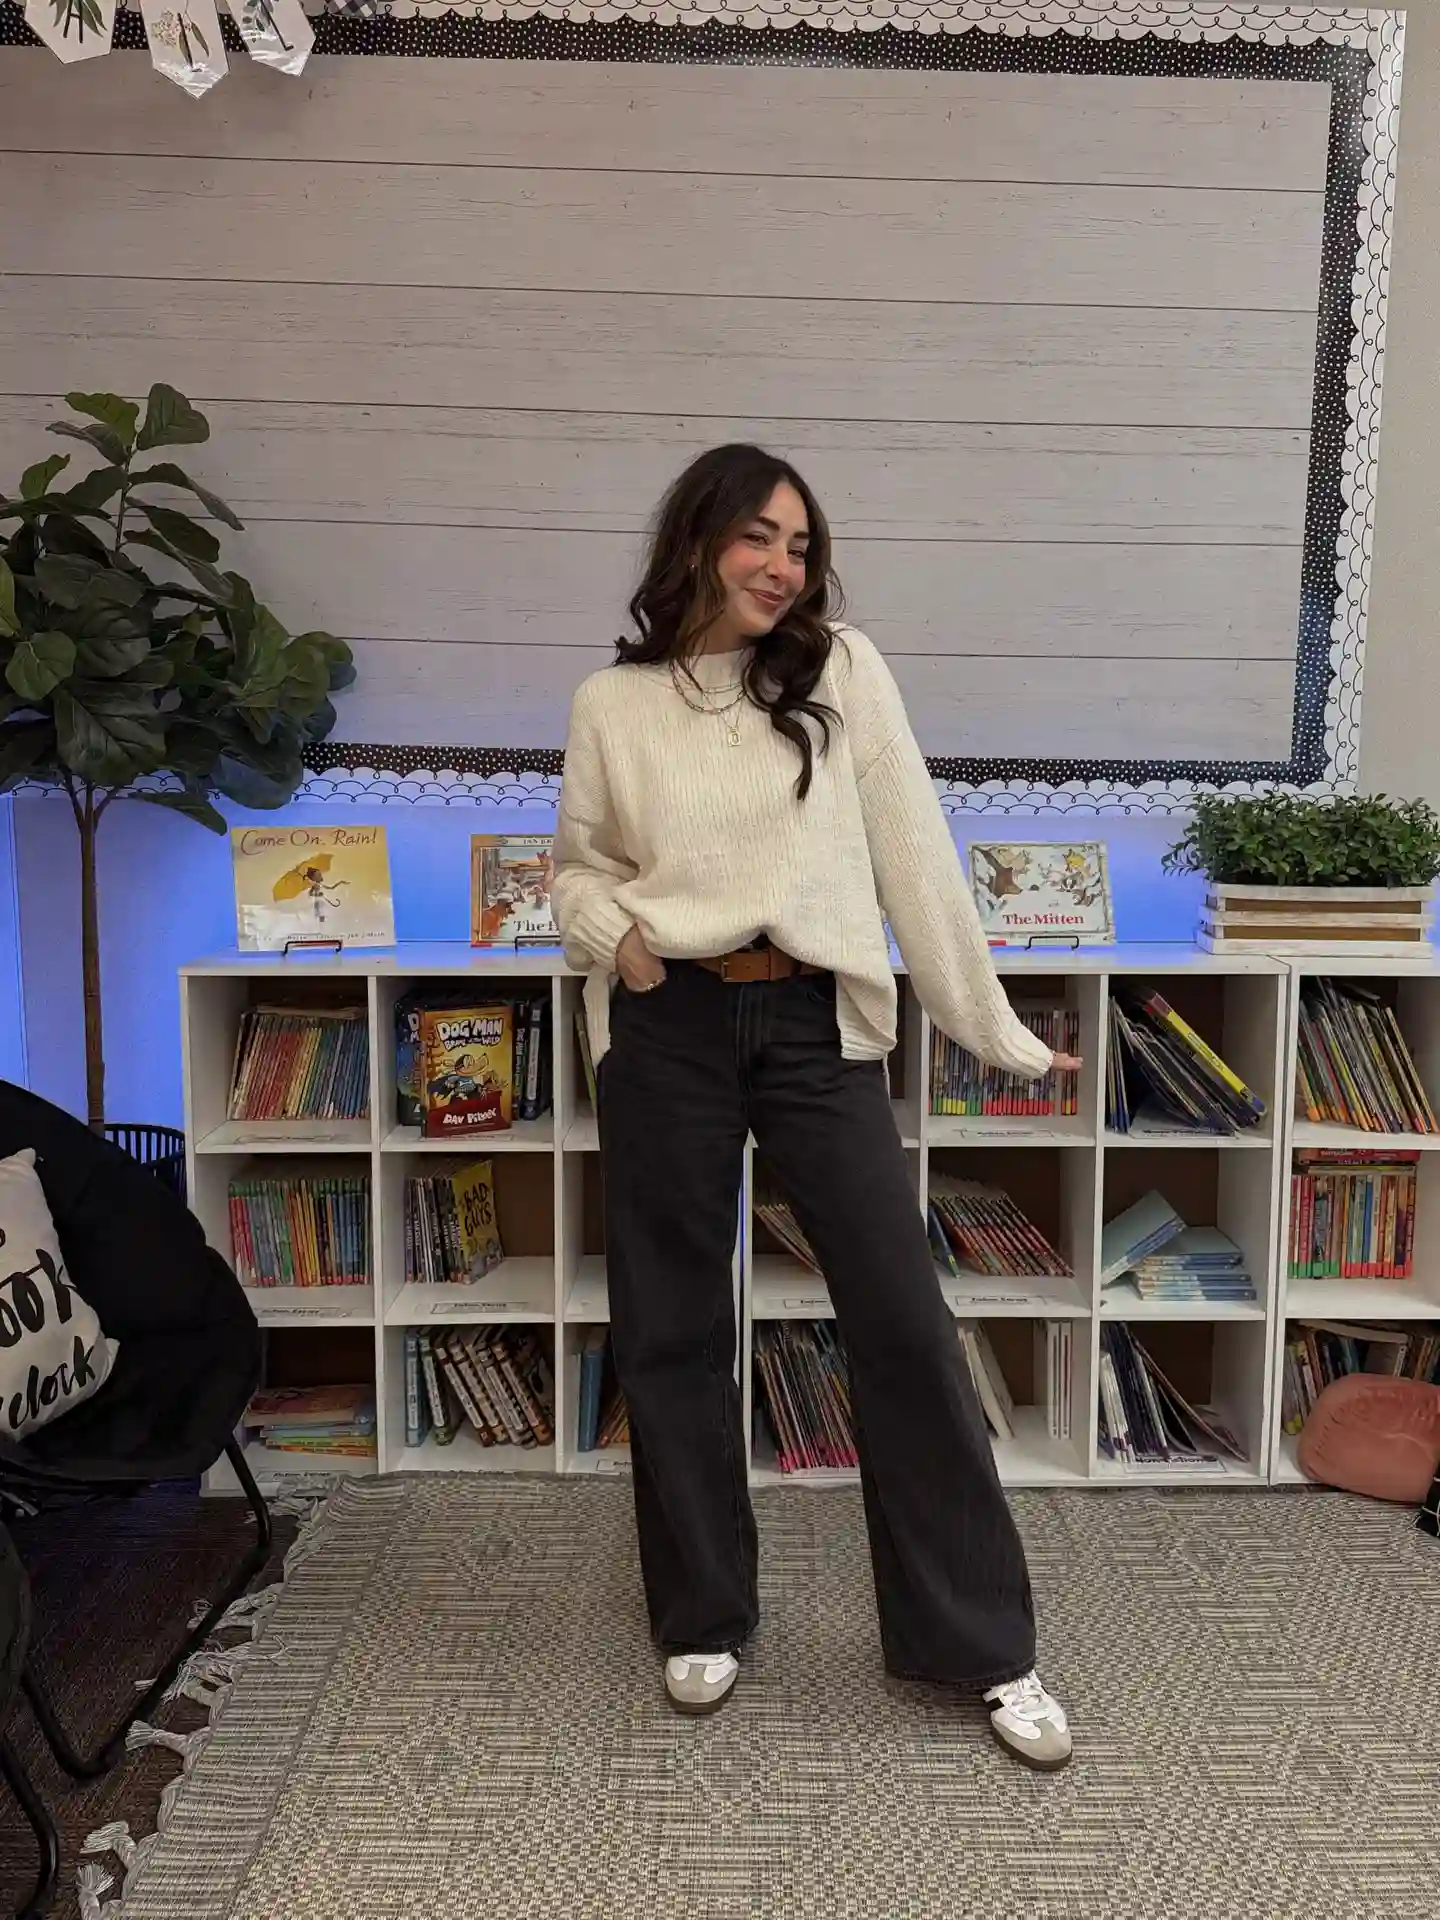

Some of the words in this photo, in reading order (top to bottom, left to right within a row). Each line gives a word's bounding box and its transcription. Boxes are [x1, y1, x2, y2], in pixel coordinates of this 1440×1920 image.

[240, 829, 285, 856] Come
[331, 827, 377, 847] Rain!
[513, 919, 545, 932] The
[1002, 914, 1032, 925] The
[1034, 913, 1084, 925] Mitten
[436, 1020, 471, 1041] DOG
[472, 1018, 503, 1037] MAN
[464, 1182, 488, 1213] BAD
[465, 1202, 492, 1237] GUYS
